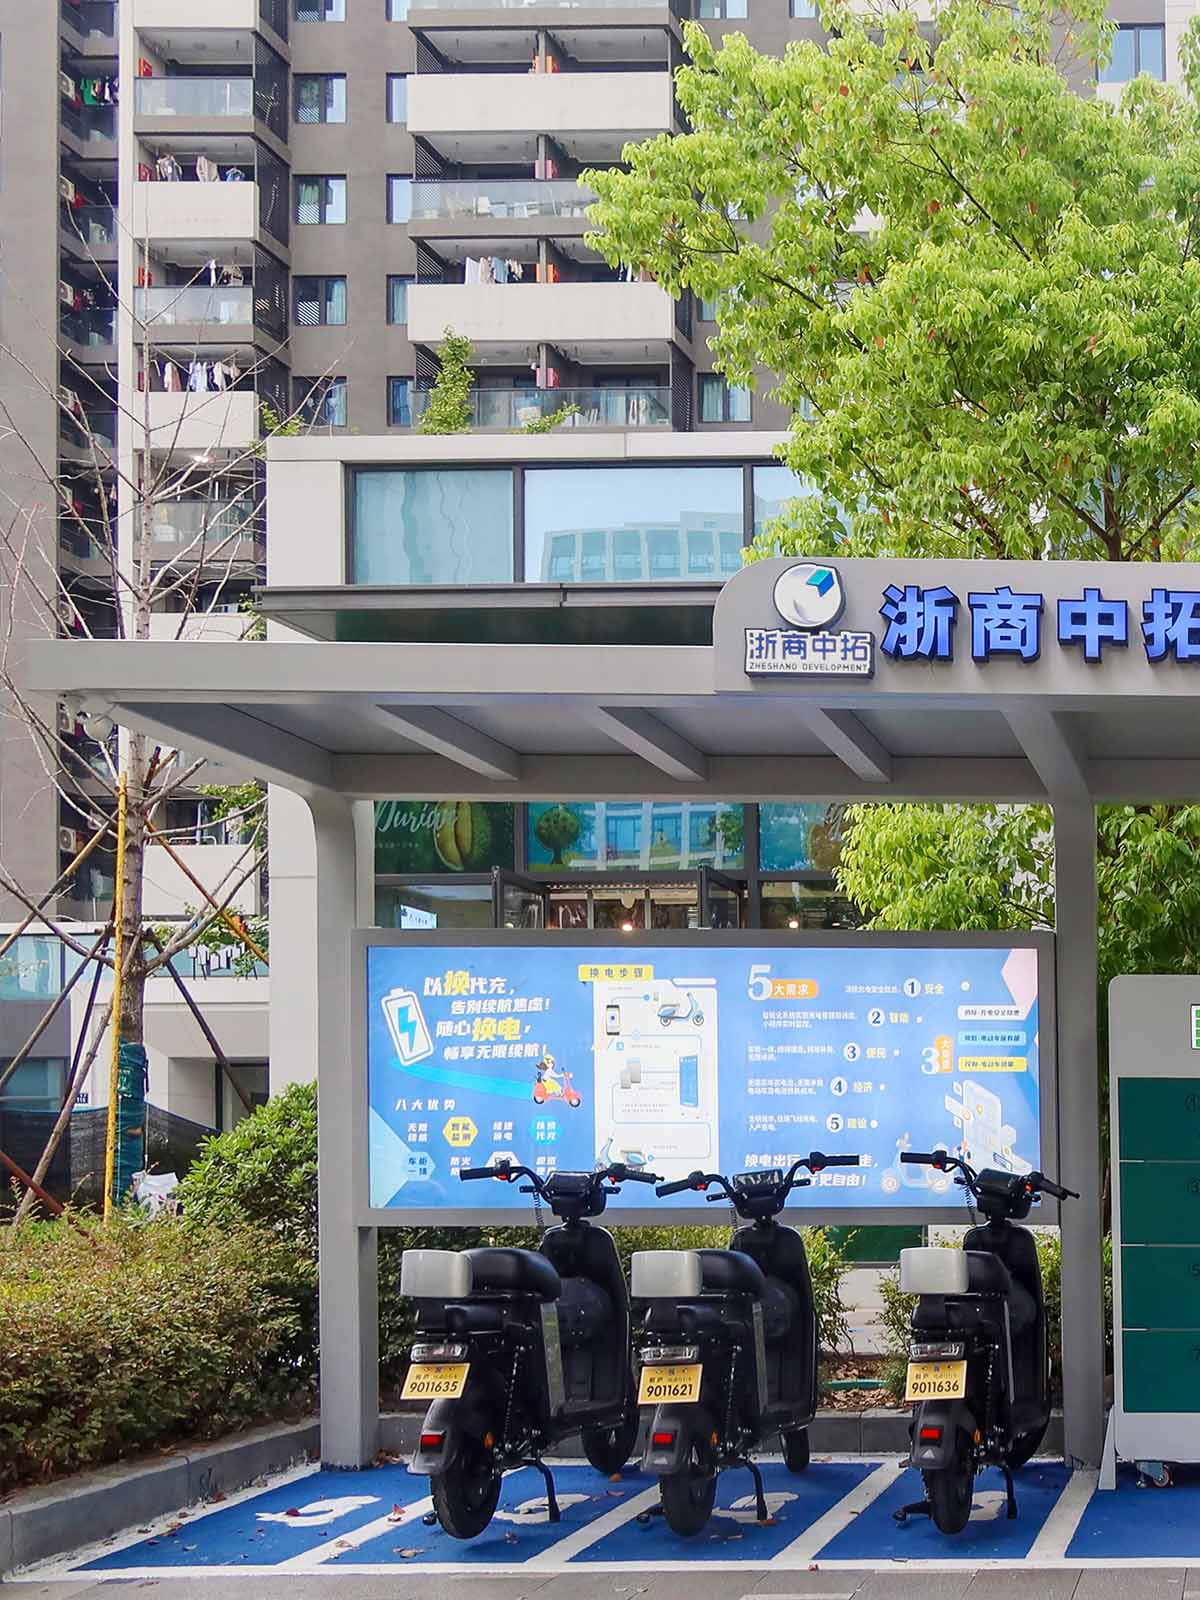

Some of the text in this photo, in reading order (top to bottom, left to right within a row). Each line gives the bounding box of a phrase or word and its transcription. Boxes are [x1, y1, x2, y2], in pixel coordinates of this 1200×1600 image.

[749, 632, 868, 661] 浙商中拓
[802, 662, 868, 672] DEVELOPMENT
[423, 970, 515, 997] 以换代充，
[435, 1016, 532, 1042] 随心换电，
[395, 1098, 456, 1111] 八大优势
[409, 1380, 459, 1393] 9011635
[646, 1383, 693, 1398] 9011621
[911, 1380, 960, 1395] 9011636
